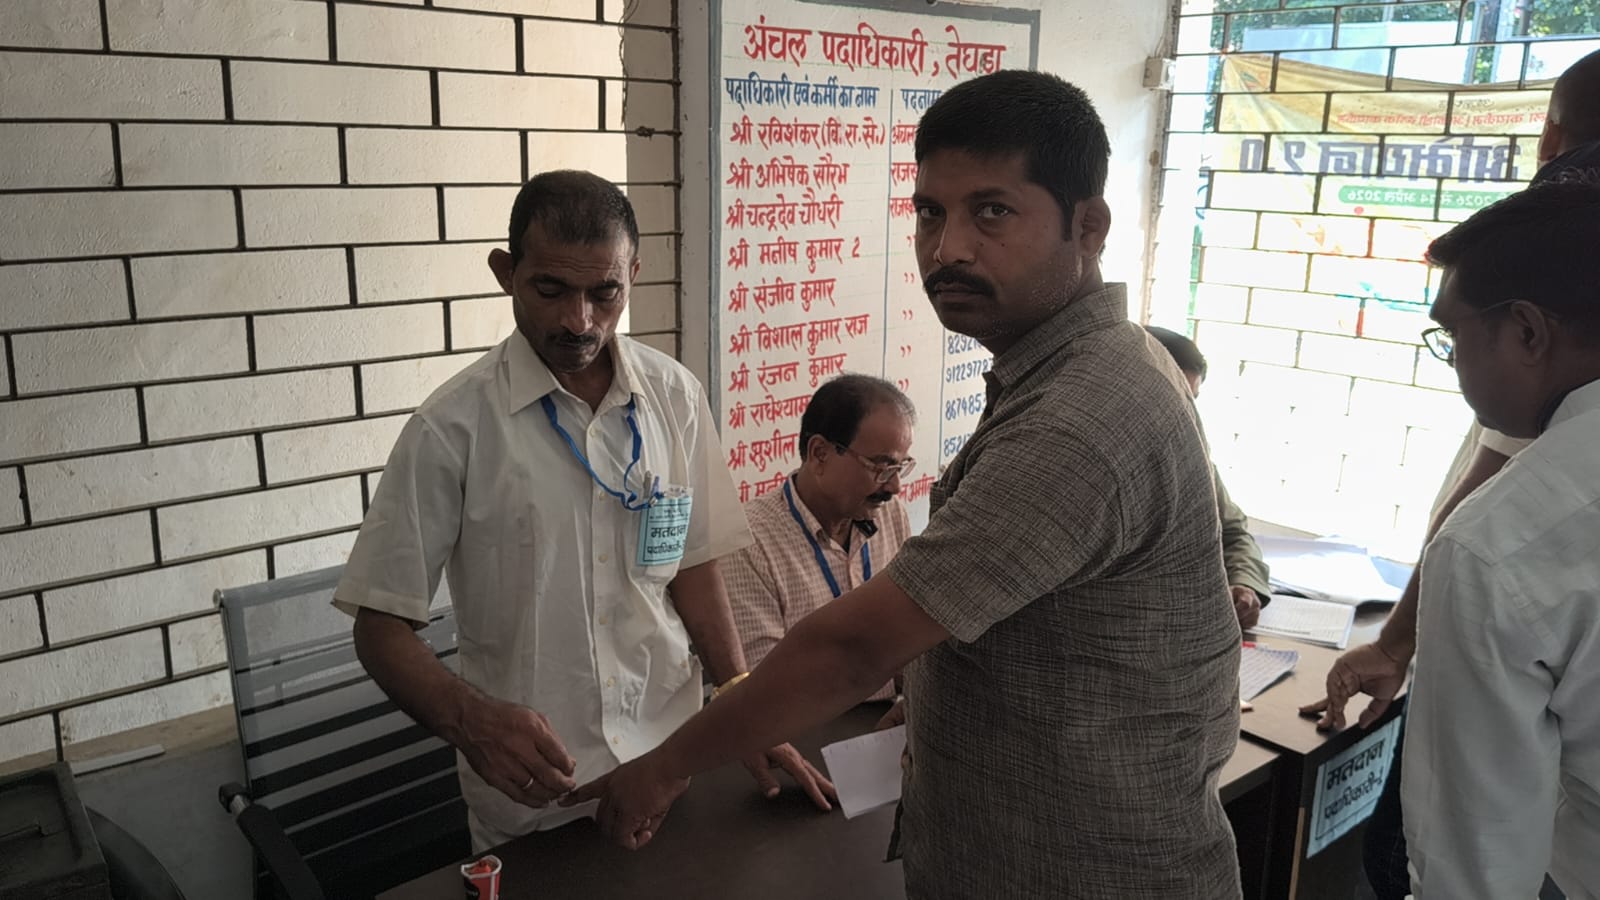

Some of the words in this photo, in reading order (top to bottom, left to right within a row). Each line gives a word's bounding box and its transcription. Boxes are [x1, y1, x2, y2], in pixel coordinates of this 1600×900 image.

[743, 14, 813, 67] अंचल
[724, 71, 793, 112] पदाधिकारी
[839, 86, 855, 108] का
[855, 86, 880, 108] नाम
[730, 115, 754, 146] श्री
[726, 157, 754, 190] श्री
[755, 154, 809, 189] अभिषेक
[813, 152, 850, 191] सौरभ
[726, 198, 745, 231] श्री
[746, 193, 799, 232] चन्द्रदेव
[799, 186, 844, 229] चौधरी
[728, 237, 750, 271] श्री
[758, 235, 800, 265] मनीष
[805, 238, 845, 274] कुमार
[851, 236, 860, 258] 2
[728, 281, 749, 313] श्री
[753, 276, 797, 314] संजीव
[800, 278, 837, 312] कुमार
[728, 324, 753, 357] श्री
[754, 322, 807, 352] विशाल
[807, 318, 842, 355] कुमार
[844, 314, 870, 339] राज
[728, 361, 750, 393] श्री
[756, 360, 800, 393] रंजन
[808, 353, 847, 388] कुमार
[729, 401, 746, 430] श्री
[728, 440, 748, 471] श्री
[943, 432, 974, 458] 8521
[650, 524, 687, 539] मतदान
[1326, 737, 1386, 791] मतदान
